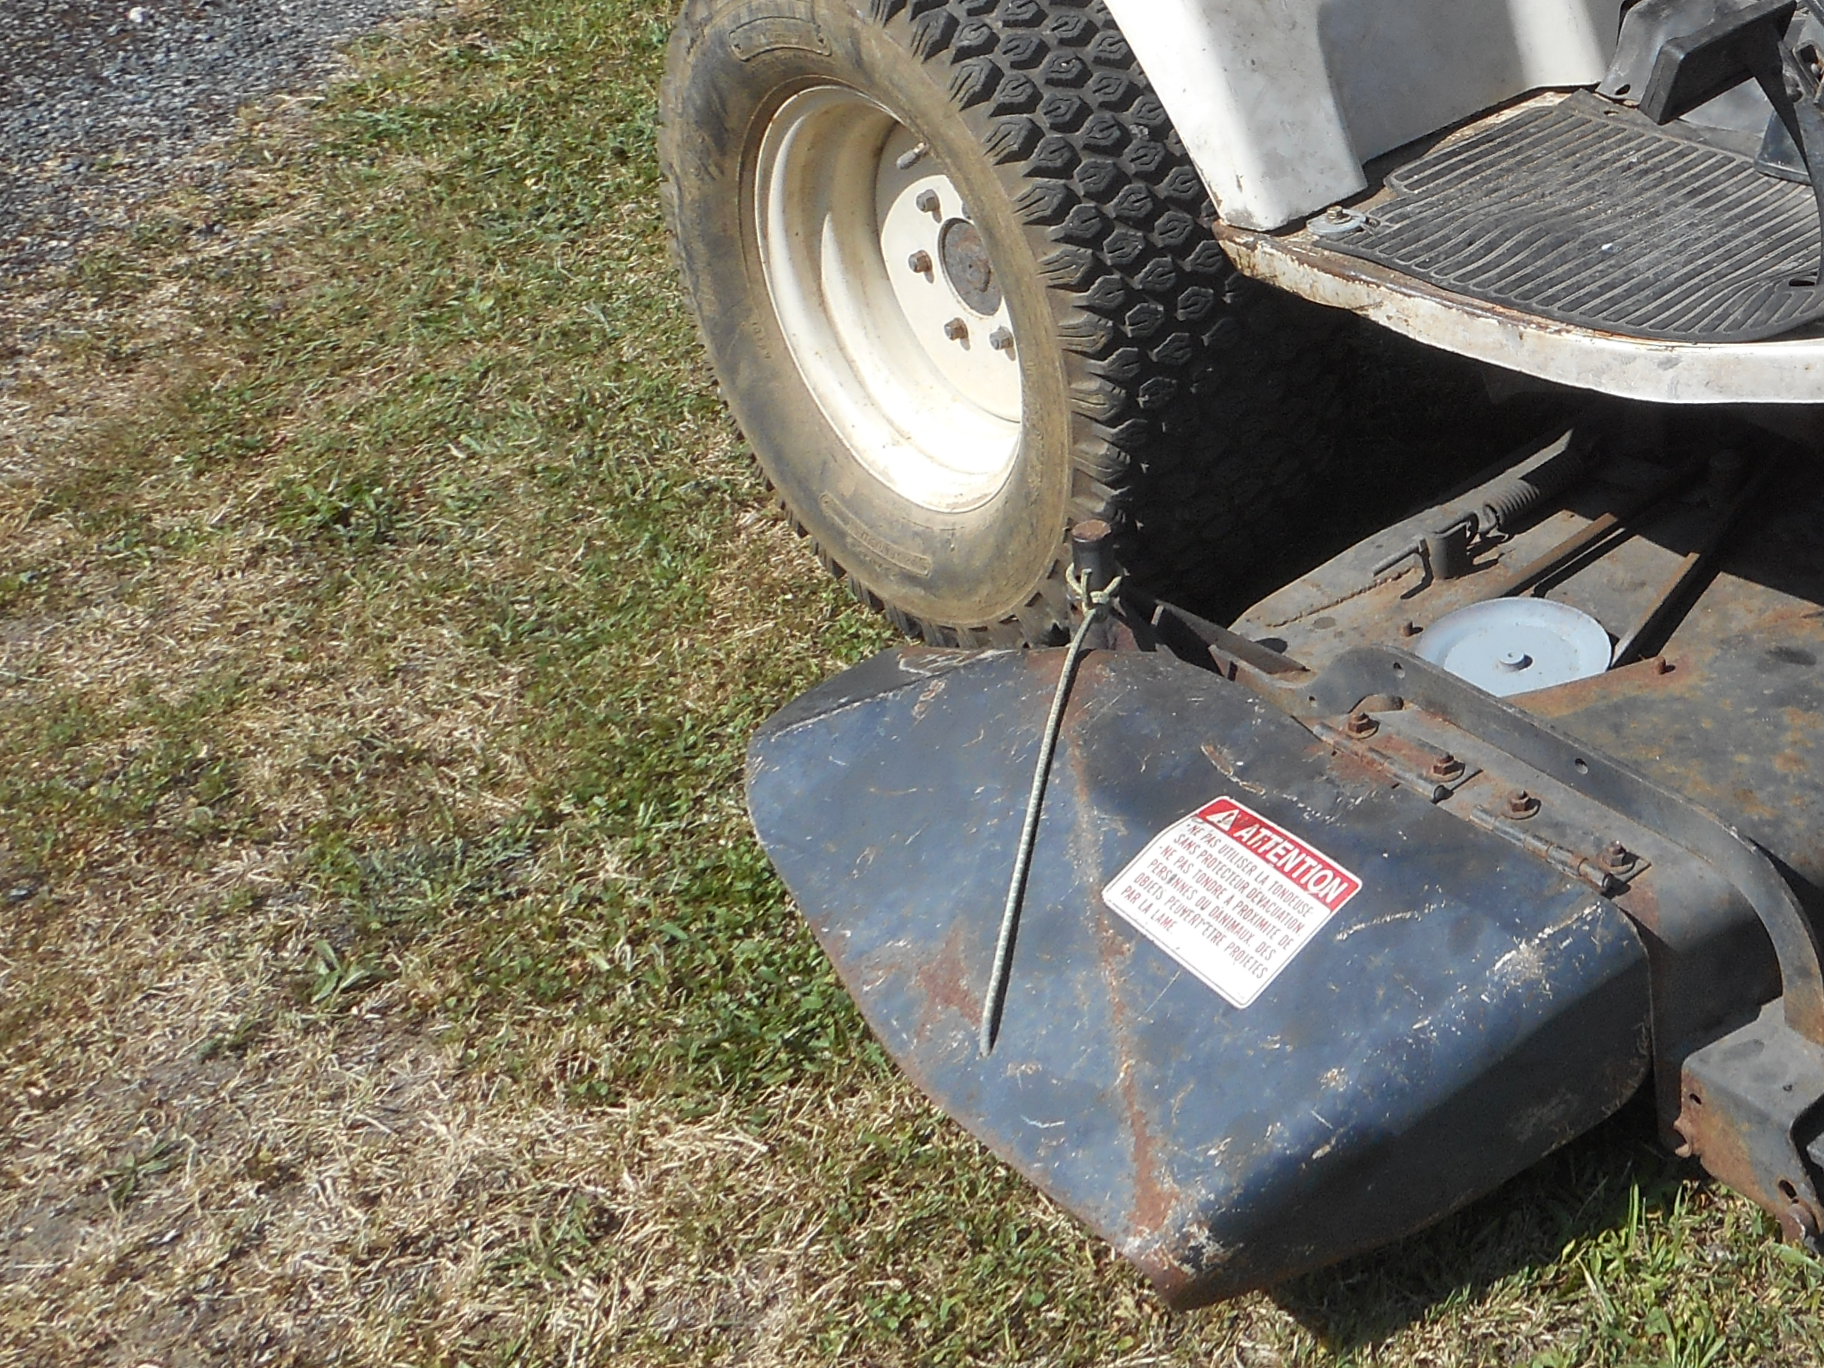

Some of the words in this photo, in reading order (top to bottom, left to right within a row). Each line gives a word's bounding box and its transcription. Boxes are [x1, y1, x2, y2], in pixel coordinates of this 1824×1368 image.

[1171, 832, 1202, 856] SANS
[1193, 849, 1252, 895] PROTECTEUR
[1215, 844, 1259, 877] UTILISER
[1265, 879, 1315, 918] TONDEUSE
[1231, 824, 1351, 905] ATTENTION
[1117, 884, 1143, 905] PAR
[1135, 898, 1156, 915] LA
[1171, 855, 1196, 875] PAS
[1189, 868, 1229, 901] TONDRE
[1275, 933, 1295, 951] DE
[1192, 894, 1213, 912] OU
[1253, 940, 1278, 962] DES
